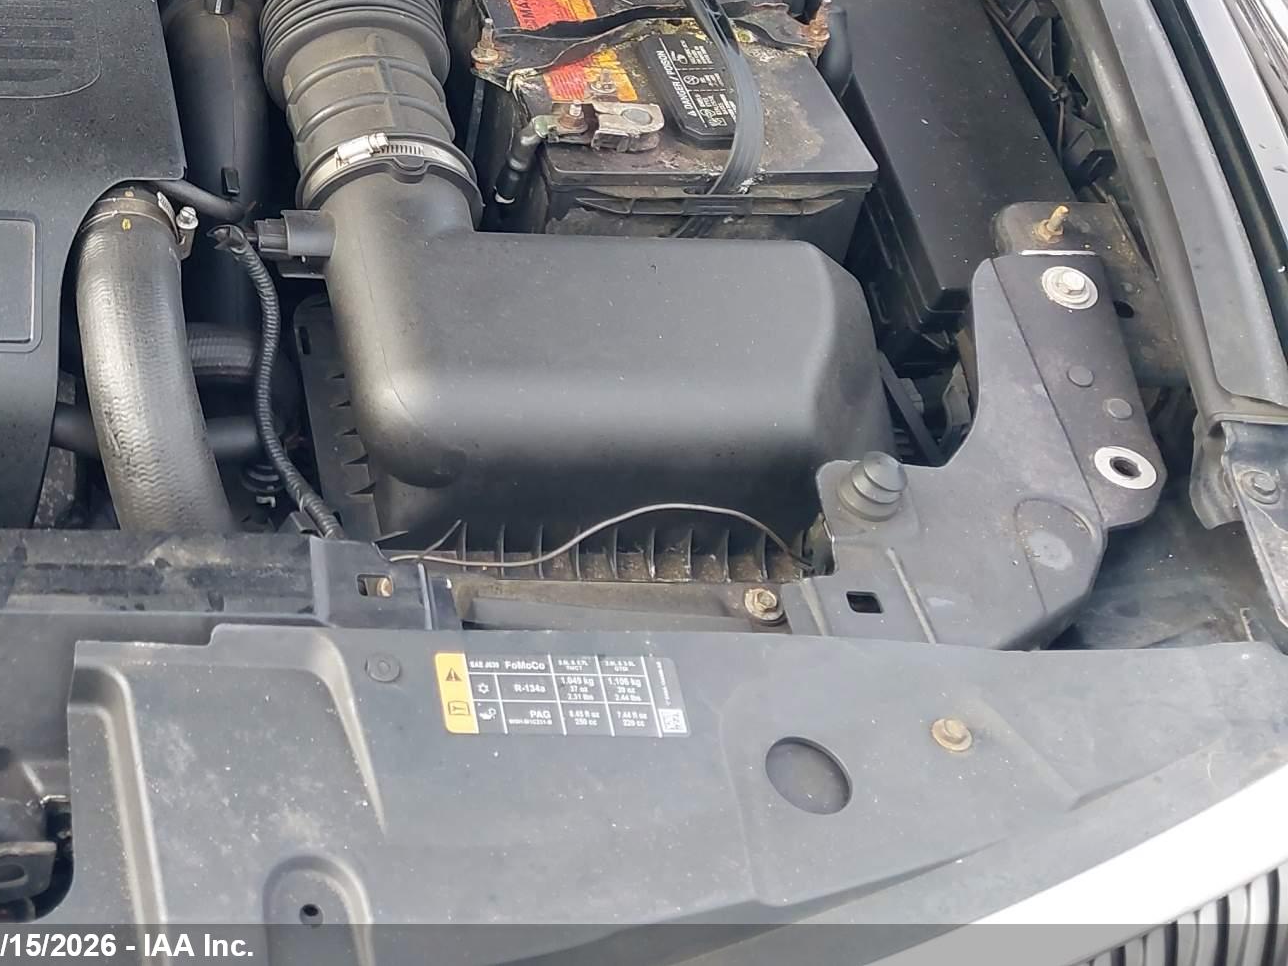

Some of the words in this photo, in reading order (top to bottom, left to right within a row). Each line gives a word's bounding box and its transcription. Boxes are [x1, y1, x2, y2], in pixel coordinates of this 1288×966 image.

[655, 49, 674, 76] POISON
[671, 80, 694, 111] DANGER
[504, 660, 546, 671] FoMoCo
[514, 683, 546, 693] R-134a
[529, 709, 552, 719] PAG
